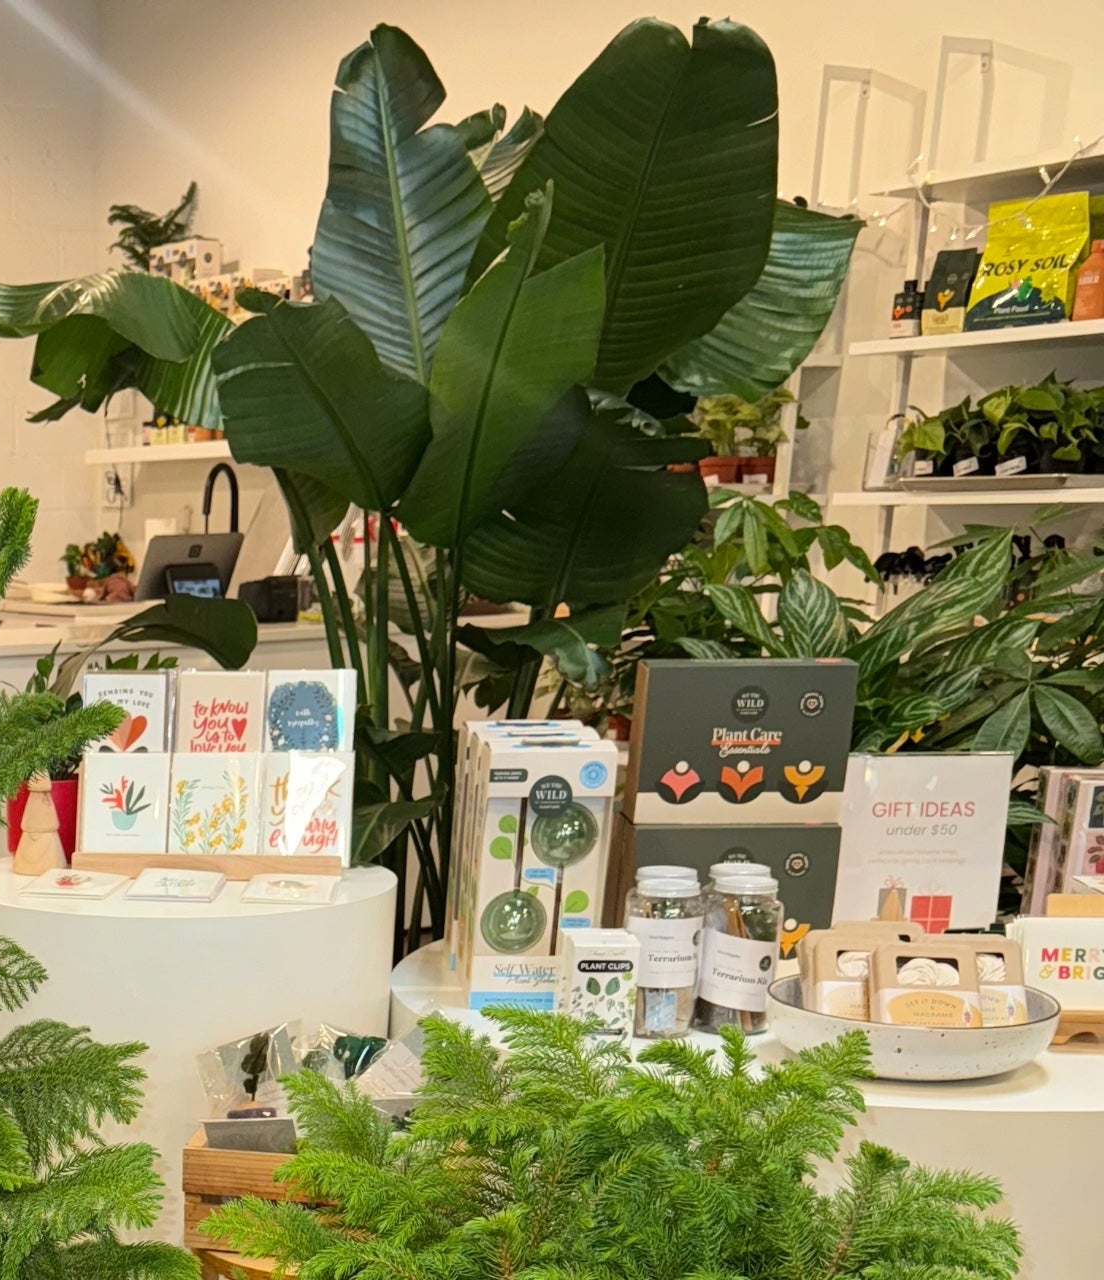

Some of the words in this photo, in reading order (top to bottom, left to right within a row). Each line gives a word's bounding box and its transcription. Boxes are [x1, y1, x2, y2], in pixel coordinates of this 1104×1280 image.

[982, 259, 1027, 276] ROSY
[1030, 254, 1068, 272] SOIL
[140, 690, 154, 698] YOU
[132, 699, 151, 709] LOVE
[192, 700, 208, 718] to
[736, 699, 765, 708] WILD
[193, 716, 230, 739] you
[712, 727, 748, 742] Plant
[750, 727, 783, 742] Care
[206, 731, 221, 744] is
[719, 741, 772, 758] Essentials
[535, 790, 568, 800] WILD
[871, 801, 914, 818] GIFT
[919, 801, 976, 818] IDEAS
[886, 824, 928, 836] under
[930, 823, 958, 836] $50
[648, 953, 693, 962] Terrarium
[1041, 948, 1104, 963] MERR
[580, 962, 606, 970] PLANT
[607, 962, 631, 970] CLIPS
[1039, 964, 1056, 980] &
[1058, 965, 1104, 981] BRIG
[712, 967, 756, 984] Terrarium
